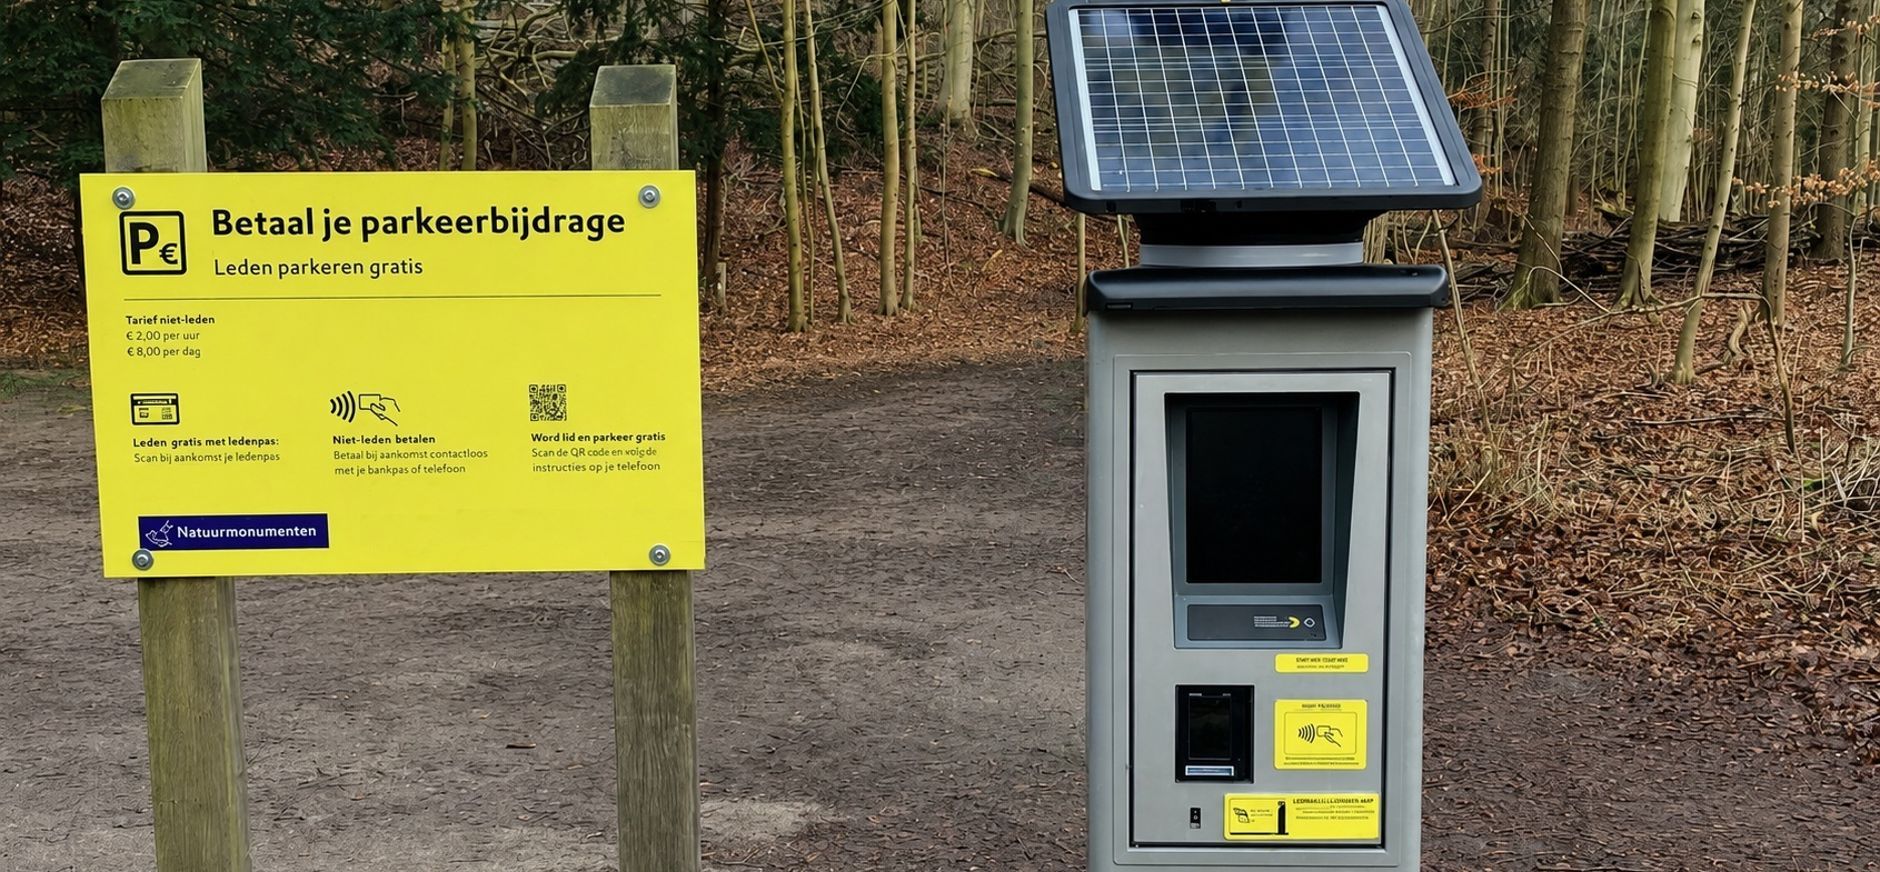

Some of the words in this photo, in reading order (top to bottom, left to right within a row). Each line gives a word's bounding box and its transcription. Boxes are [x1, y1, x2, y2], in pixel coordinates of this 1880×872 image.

[212, 207, 314, 236] Betaal
[322, 208, 351, 242] je
[361, 206, 625, 243] parkeerbijdrage
[214, 258, 273, 276] Leden
[279, 258, 363, 279] parkeren
[369, 258, 424, 279] gratis
[126, 314, 158, 325] Tarief
[160, 314, 216, 324] niet-leden
[126, 331, 134, 341] €
[136, 331, 161, 342] 2,00
[163, 332, 180, 342] per
[183, 332, 200, 340] uur
[127, 347, 134, 356] €
[136, 346, 161, 358] 8,00
[163, 348, 180, 358] per
[182, 346, 201, 358] dag
[133, 437, 167, 448] Leden
[171, 437, 202, 449] gratis
[205, 438, 226, 447] met
[228, 436, 279, 448] ledenpas:
[332, 435, 391, 444] Niet-leden
[395, 434, 436, 444] betalen
[531, 433, 560, 442] Word
[562, 432, 576, 442] lid
[577, 434, 591, 442] en
[593, 432, 633, 444] parkeer
[635, 432, 666, 443] gratis
[134, 453, 158, 463] Scan
[160, 453, 172, 464] bij
[174, 453, 222, 462] aankomst
[224, 453, 234, 464] je
[235, 452, 280, 463] ledenpas
[334, 450, 364, 460] Betaal
[366, 450, 378, 461] bij
[380, 450, 428, 459] aankomst
[430, 449, 488, 458] contactloos
[531, 448, 555, 457] Scan
[556, 448, 568, 457] de
[570, 448, 586, 457] QR
[587, 448, 610, 457] code
[646, 447, 657, 456] de
[335, 467, 354, 475] met
[356, 465, 365, 476] je
[368, 465, 409, 476] bankpas
[411, 464, 421, 474] of
[423, 464, 466, 473] telefoon
[532, 462, 586, 472] instructies
[588, 464, 603, 473] op
[604, 462, 615, 473] je
[617, 461, 660, 471] telefoon
[177, 525, 317, 539] Natuurmonumenten
